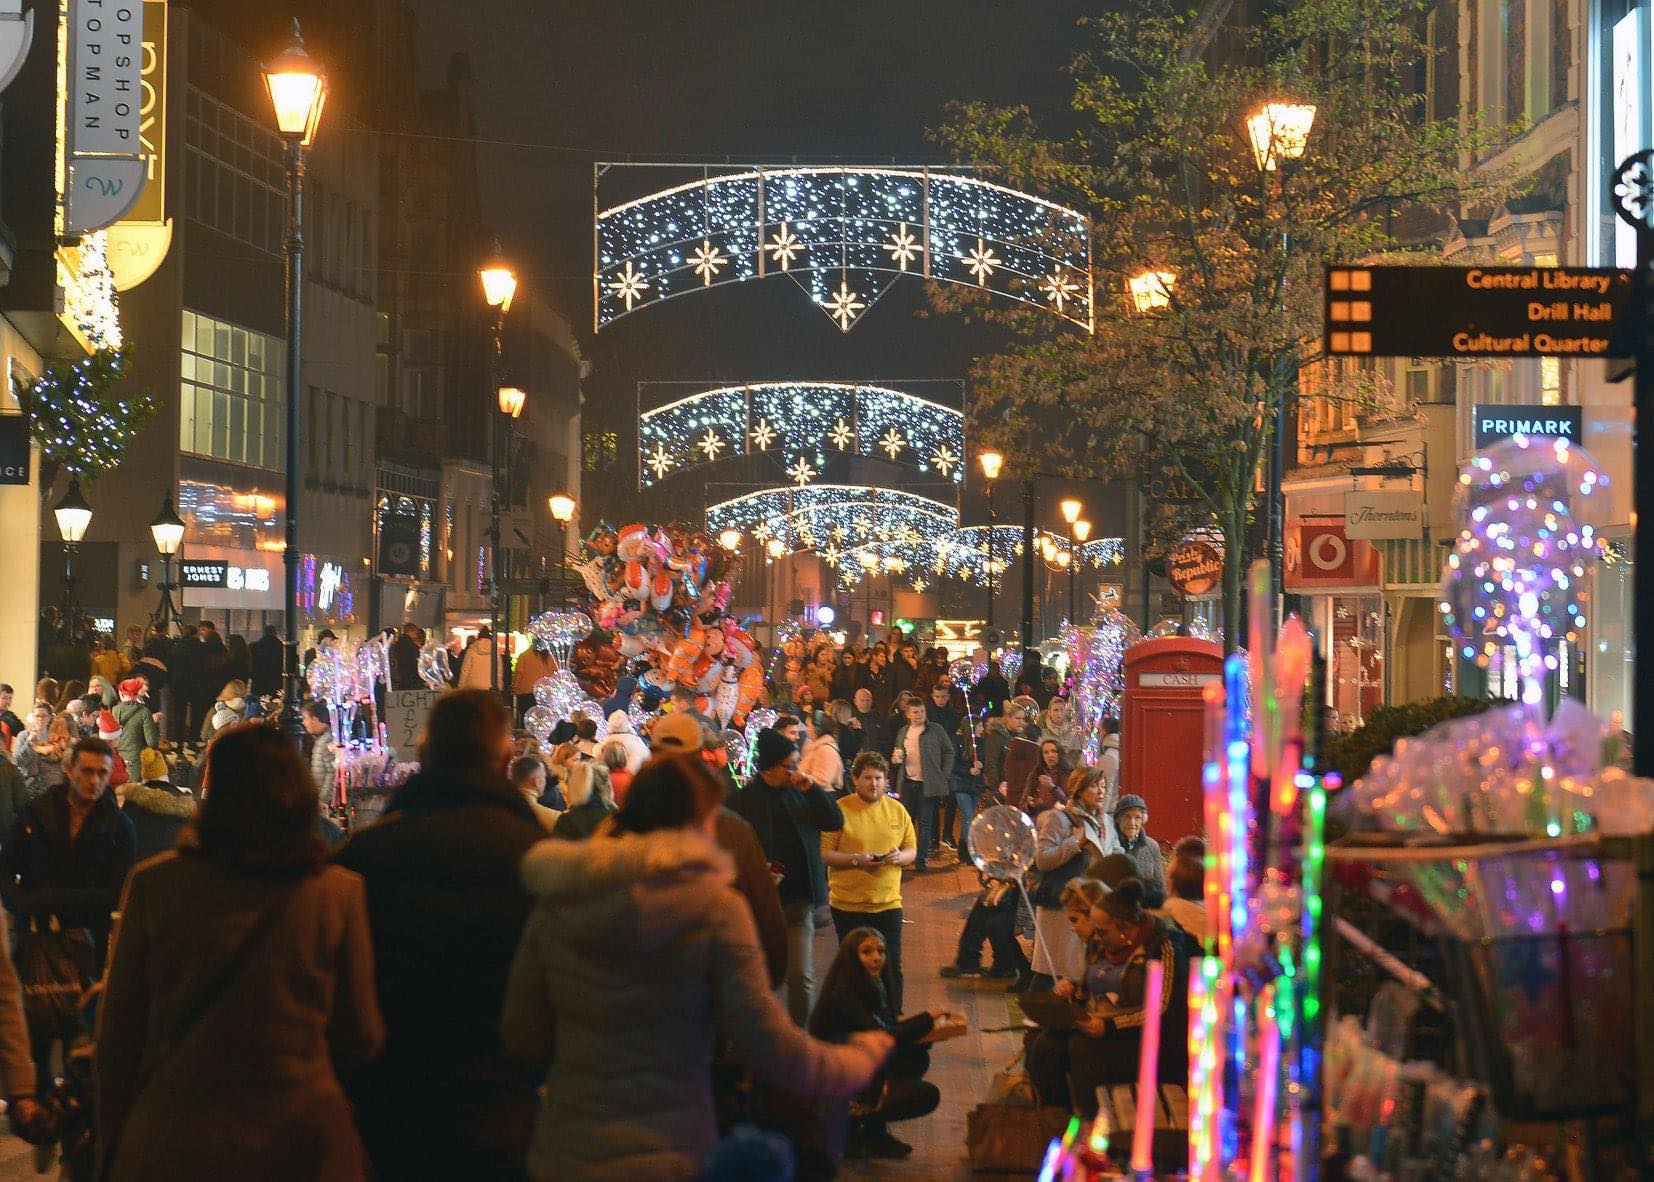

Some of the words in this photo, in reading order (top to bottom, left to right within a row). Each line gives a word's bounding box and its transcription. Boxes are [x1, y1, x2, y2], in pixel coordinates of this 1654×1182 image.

[1466, 269, 1538, 289] Central
[1543, 271, 1611, 294] Library
[1527, 302, 1569, 321] Drill
[1573, 302, 1612, 321] Hall
[1452, 331, 1530, 352] Cultural
[1533, 333, 1610, 353] Quarter
[1482, 419, 1573, 434] PRIMARK
[1351, 505, 1418, 525] Thorntons
[183, 565, 225, 574] ERNEST
[186, 574, 221, 582] JONES
[1163, 674, 1199, 686] CASH
